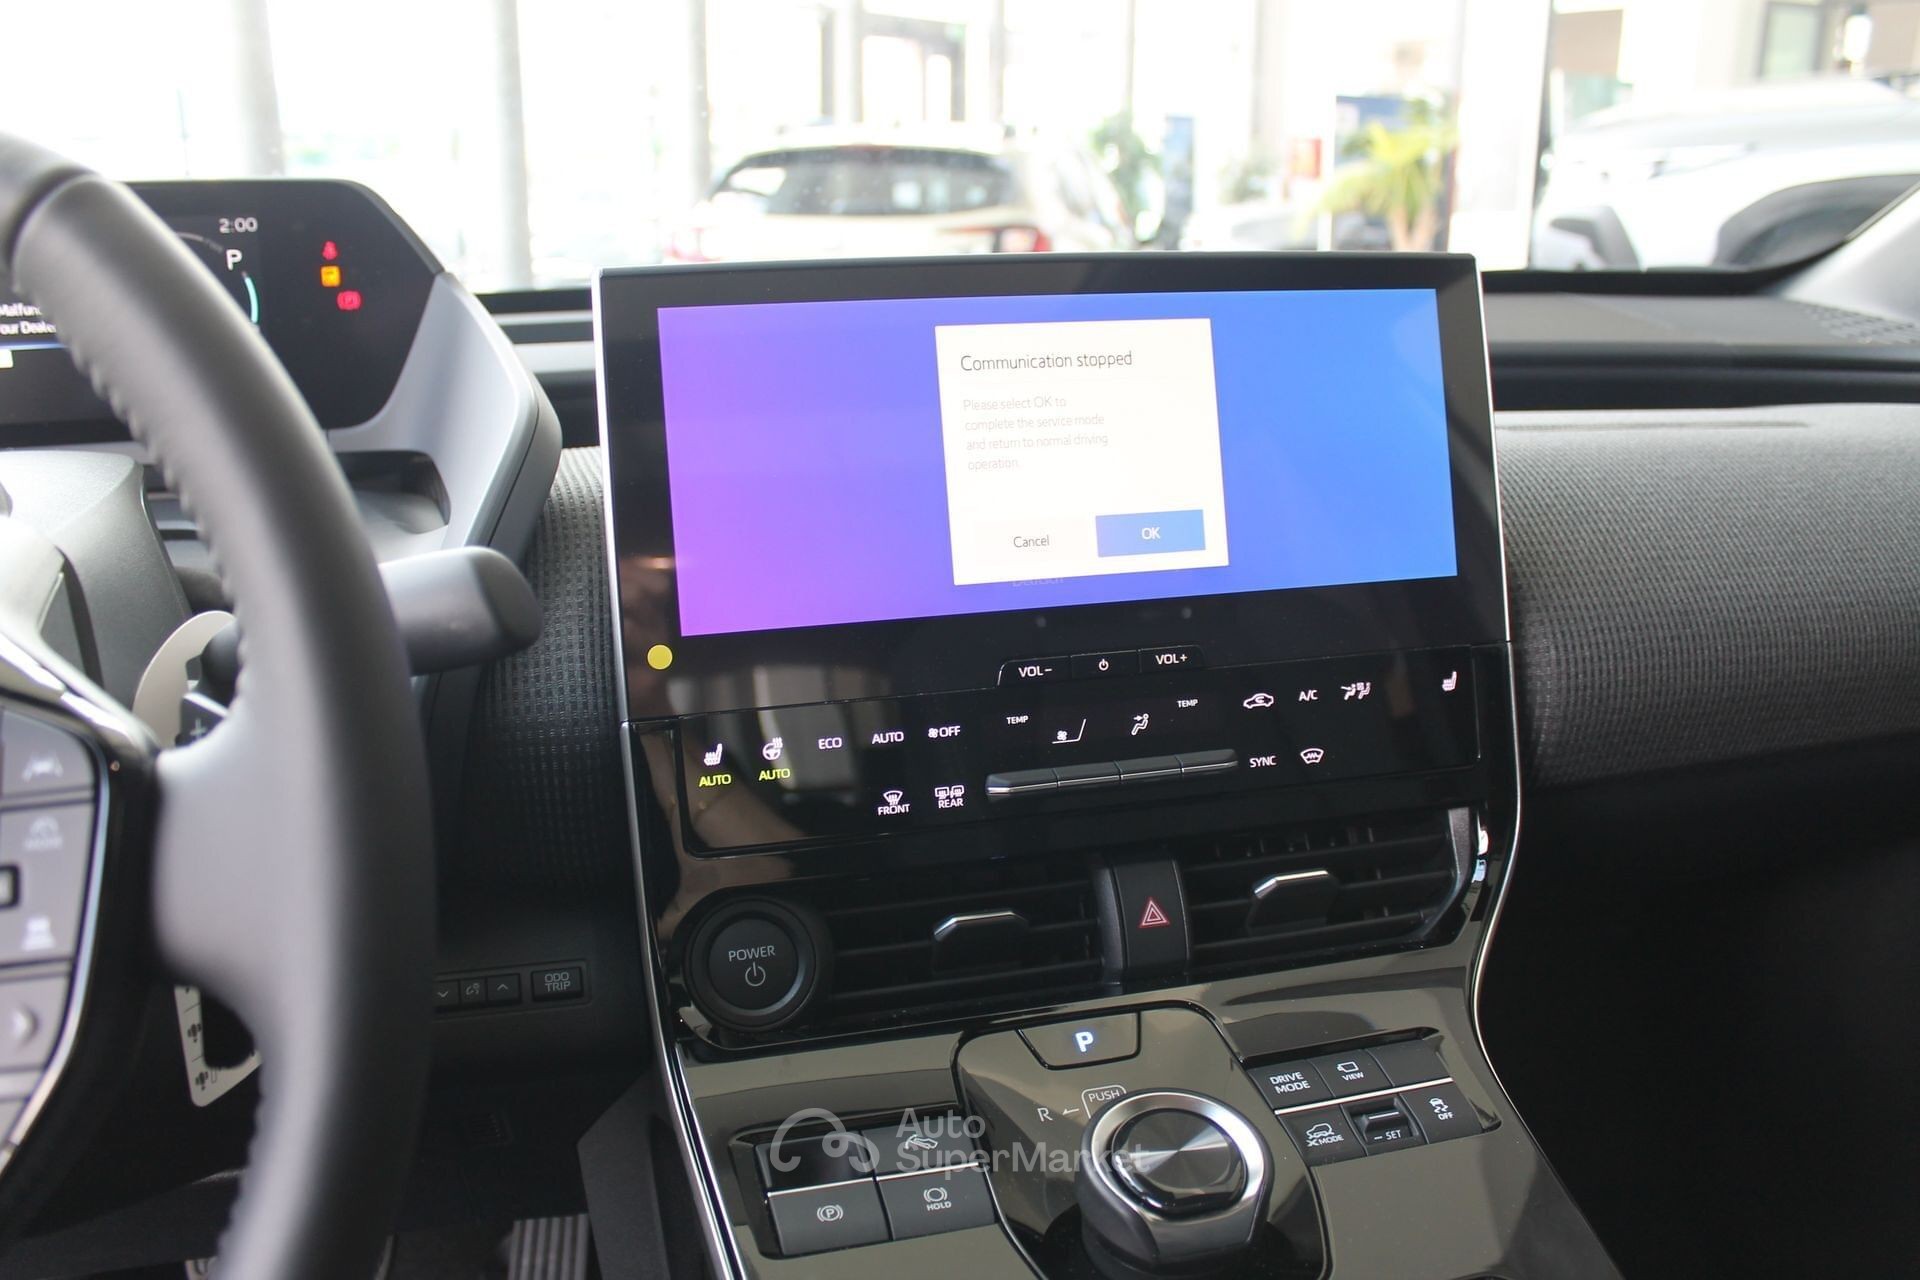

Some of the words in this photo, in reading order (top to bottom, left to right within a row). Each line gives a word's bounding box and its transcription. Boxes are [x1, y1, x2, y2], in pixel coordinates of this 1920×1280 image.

[218, 217, 258, 233] 2:00
[225, 248, 243, 271] P
[20, 320, 57, 335] Deale
[960, 352, 1073, 371] Communication
[1076, 350, 1133, 369] stopped
[963, 398, 998, 411] Please
[1000, 397, 1031, 409] select
[1033, 395, 1052, 408] OK
[1055, 396, 1067, 408] to
[965, 418, 1015, 433] complete
[1016, 417, 1035, 429] the
[1036, 416, 1072, 428] service
[1074, 413, 1105, 425] mode
[966, 438, 986, 451] and
[988, 438, 1021, 449] return
[1023, 437, 1034, 448] to
[1036, 434, 1072, 447] normal
[1073, 432, 1109, 447] driving
[1013, 534, 1050, 549] Cancel
[1141, 527, 1161, 540] OK
[1155, 653, 1188, 666] VOL+
[1299, 689, 1318, 702] A/C
[1177, 698, 1199, 709] TEMP
[1006, 714, 1029, 726] TEMP
[871, 730, 904, 745] AUTO
[939, 725, 961, 738] OFF
[818, 736, 843, 750] ECO
[1249, 755, 1277, 768] SYNC
[699, 773, 732, 788] AUTO
[758, 767, 791, 783] AUTO
[877, 803, 910, 816] FRONT
[937, 797, 964, 809] REAR
[728, 945, 776, 962] POWER
[544, 971, 570, 983] ODO
[544, 980, 571, 993] TRIP
[1074, 1030, 1094, 1053] P
[1269, 1071, 1305, 1086] DRIVE
[1341, 1071, 1364, 1082] VIEW
[1274, 1079, 1311, 1095] MODE
[1087, 1088, 1121, 1104] PUSH
[1037, 1106, 1053, 1122] R
[1437, 1111, 1454, 1122] OFF
[1385, 1129, 1401, 1141] SET
[926, 1199, 952, 1212] HOLD
